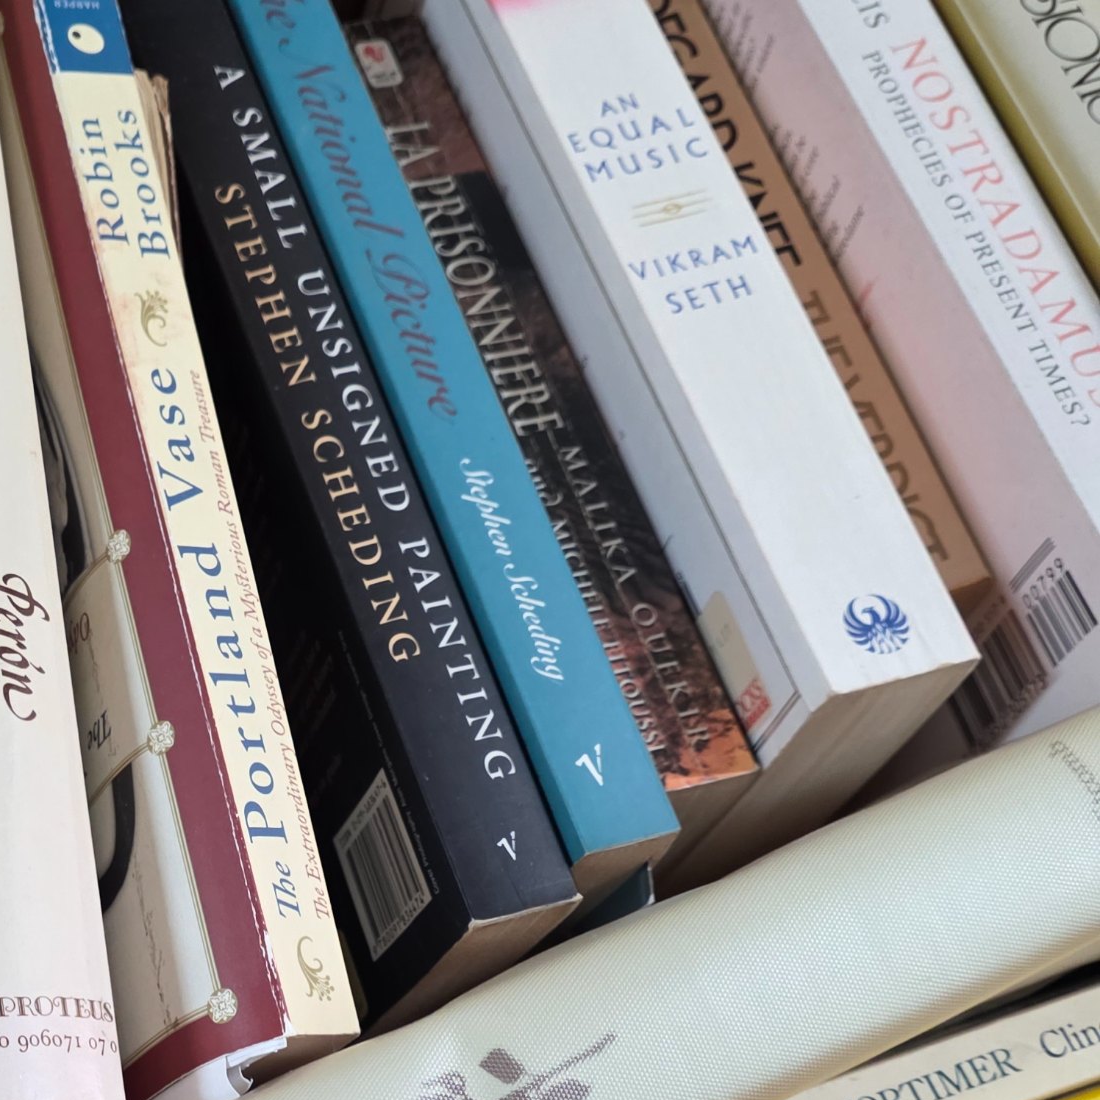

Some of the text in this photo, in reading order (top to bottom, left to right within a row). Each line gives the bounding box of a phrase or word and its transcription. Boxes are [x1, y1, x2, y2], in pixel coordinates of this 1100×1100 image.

[384, 120, 441, 167] LA
[566, 108, 696, 154] EQUAL
[583, 137, 709, 184] MUSIC
[599, 91, 642, 118] AN
[79, 117, 130, 246] Robin
[114, 108, 171, 260] Brooks
[280, 38, 458, 418] National Picture
[861, 50, 1091, 427] PROPHECIES OF PRESENT TIMES?
[628, 235, 758, 282] VIKRAM
[665, 274, 754, 315] SETH
[212, 64, 246, 91] A
[232, 106, 309, 250] SMALL
[296, 267, 411, 513] UNSIGNED
[398, 537, 517, 781] PAINTING
[214, 181, 317, 387] STEPHEN
[300, 408, 422, 663] SCHEDING
[151, 366, 302, 920] The Portland Vase
[189, 369, 331, 921] The Extraordinary Odyssey of a Mysterious Roman Treasure
[458, 457, 565, 688] Stephen Scheding
[559, 446, 710, 752] MALIKA OUFKIR
[17, 1029, 82, 1054] 906071
